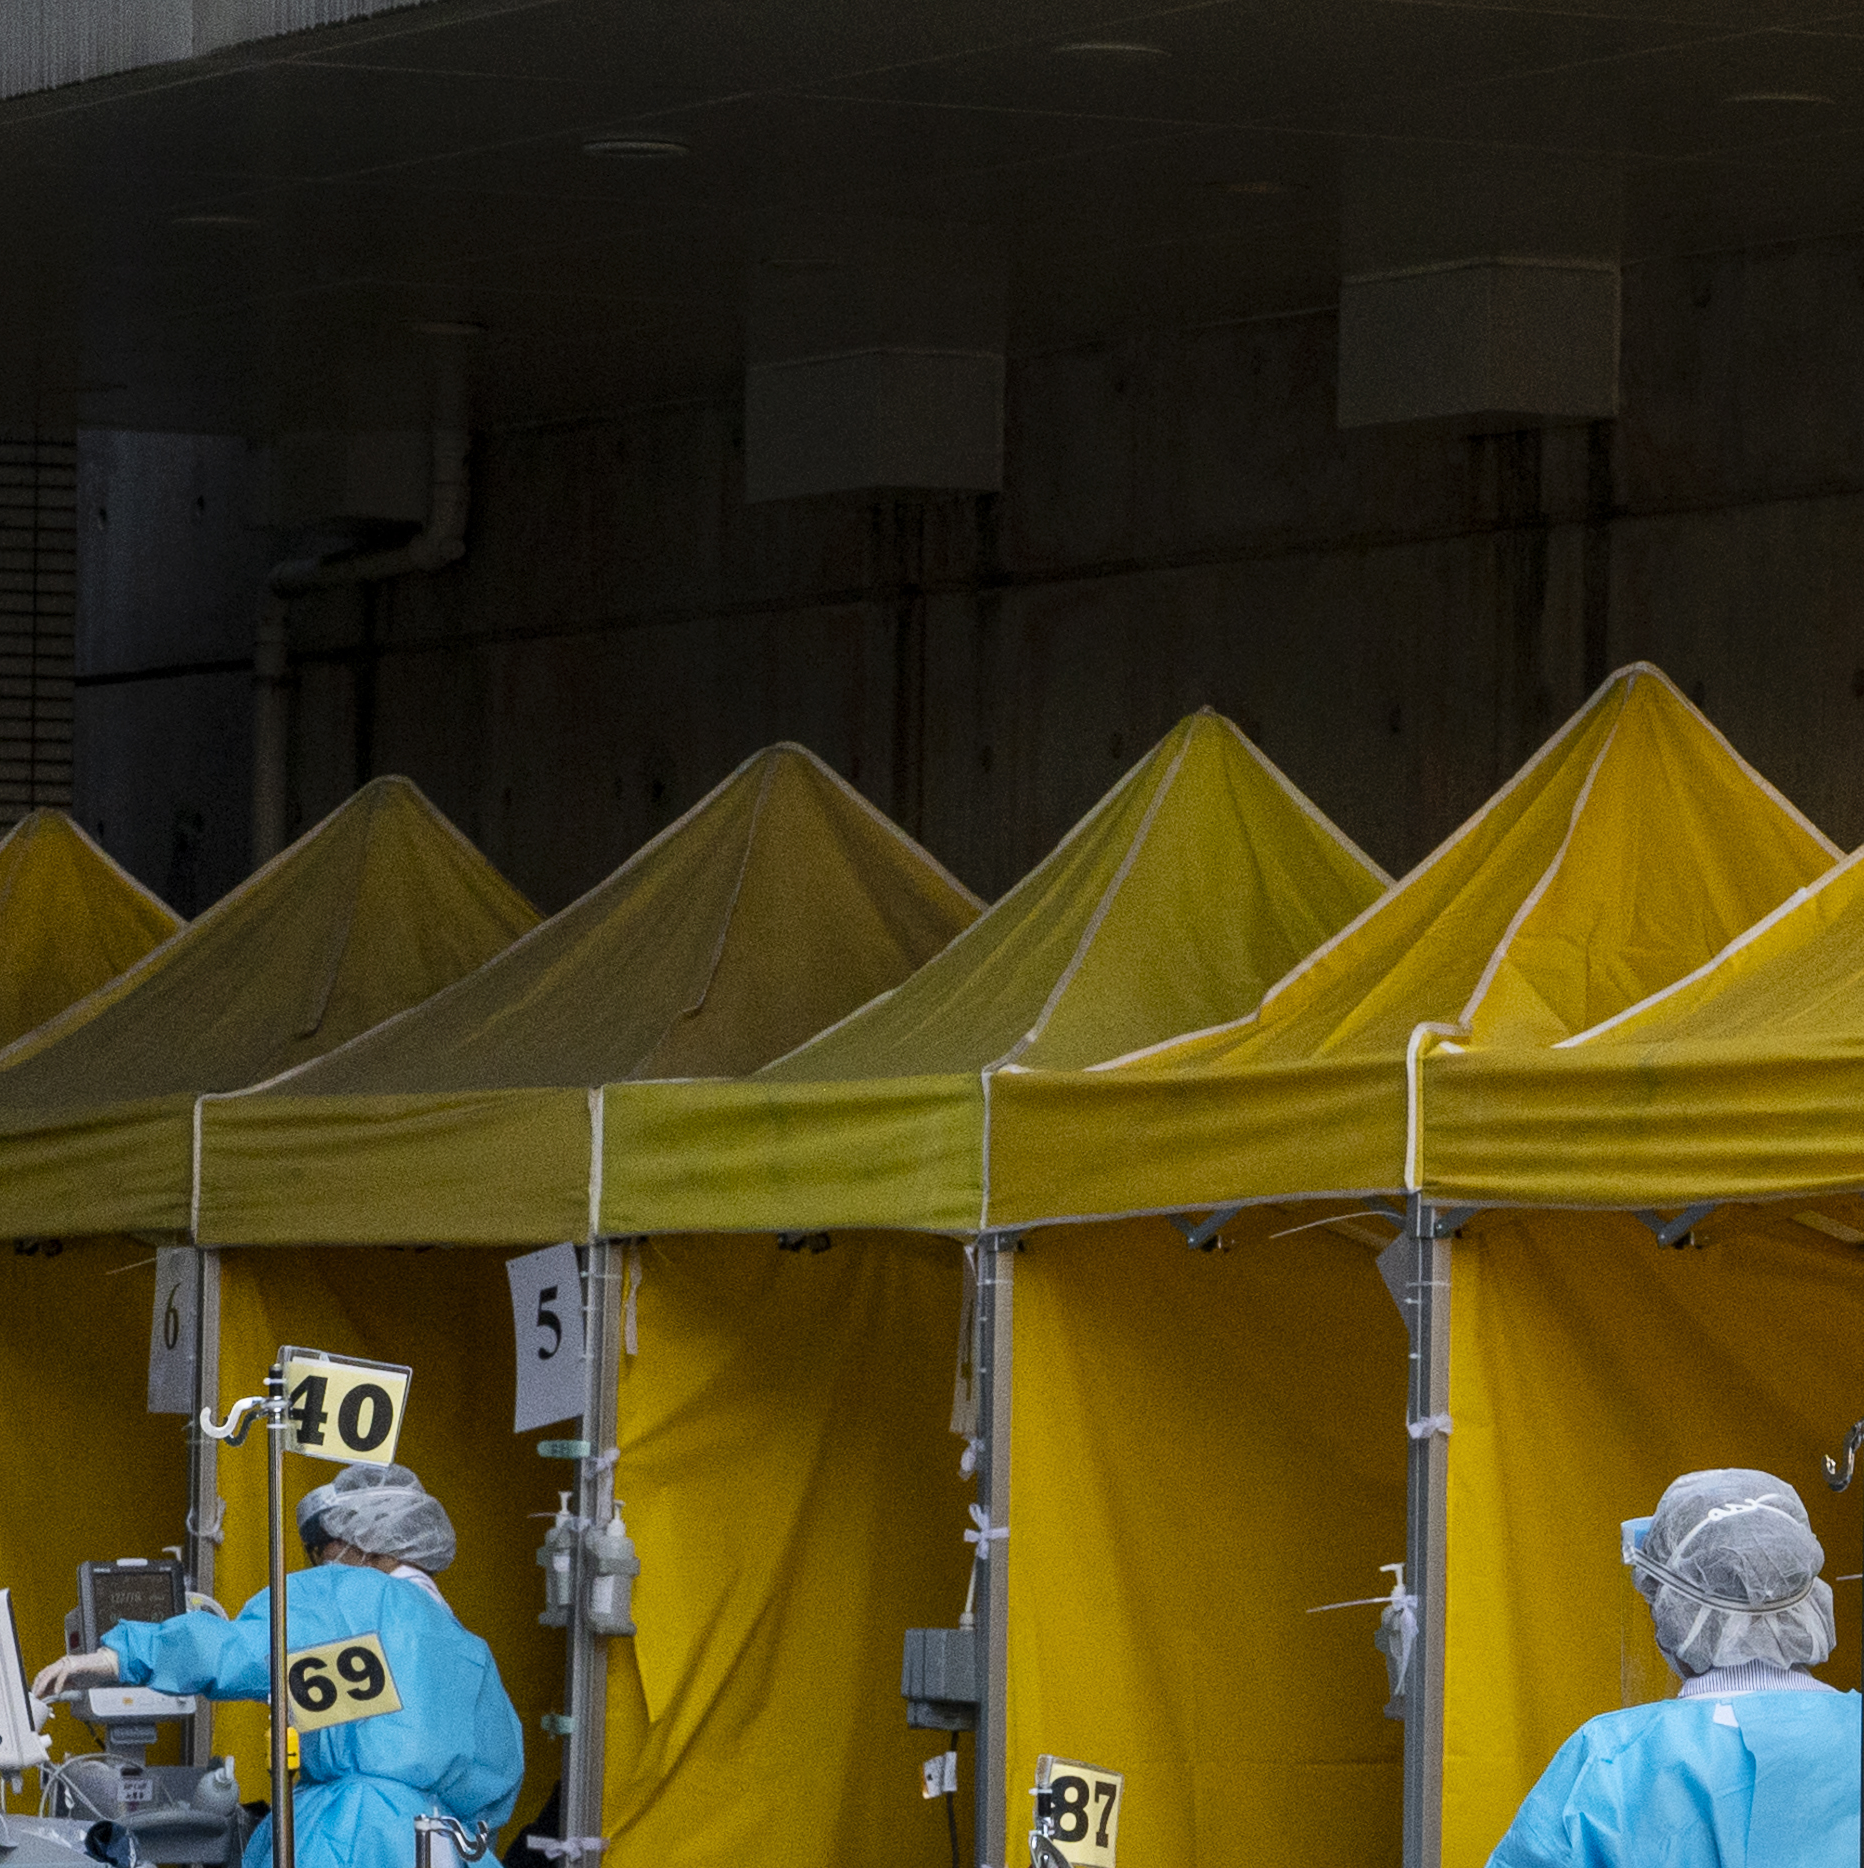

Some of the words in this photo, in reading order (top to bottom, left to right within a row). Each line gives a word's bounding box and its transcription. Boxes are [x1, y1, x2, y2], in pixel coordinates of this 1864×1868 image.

[164, 1281, 181, 1351] 6
[537, 1285, 562, 1360] 5
[289, 1375, 394, 1452] 40
[289, 1646, 386, 1713] 69
[1050, 1775, 1117, 1848] 87
